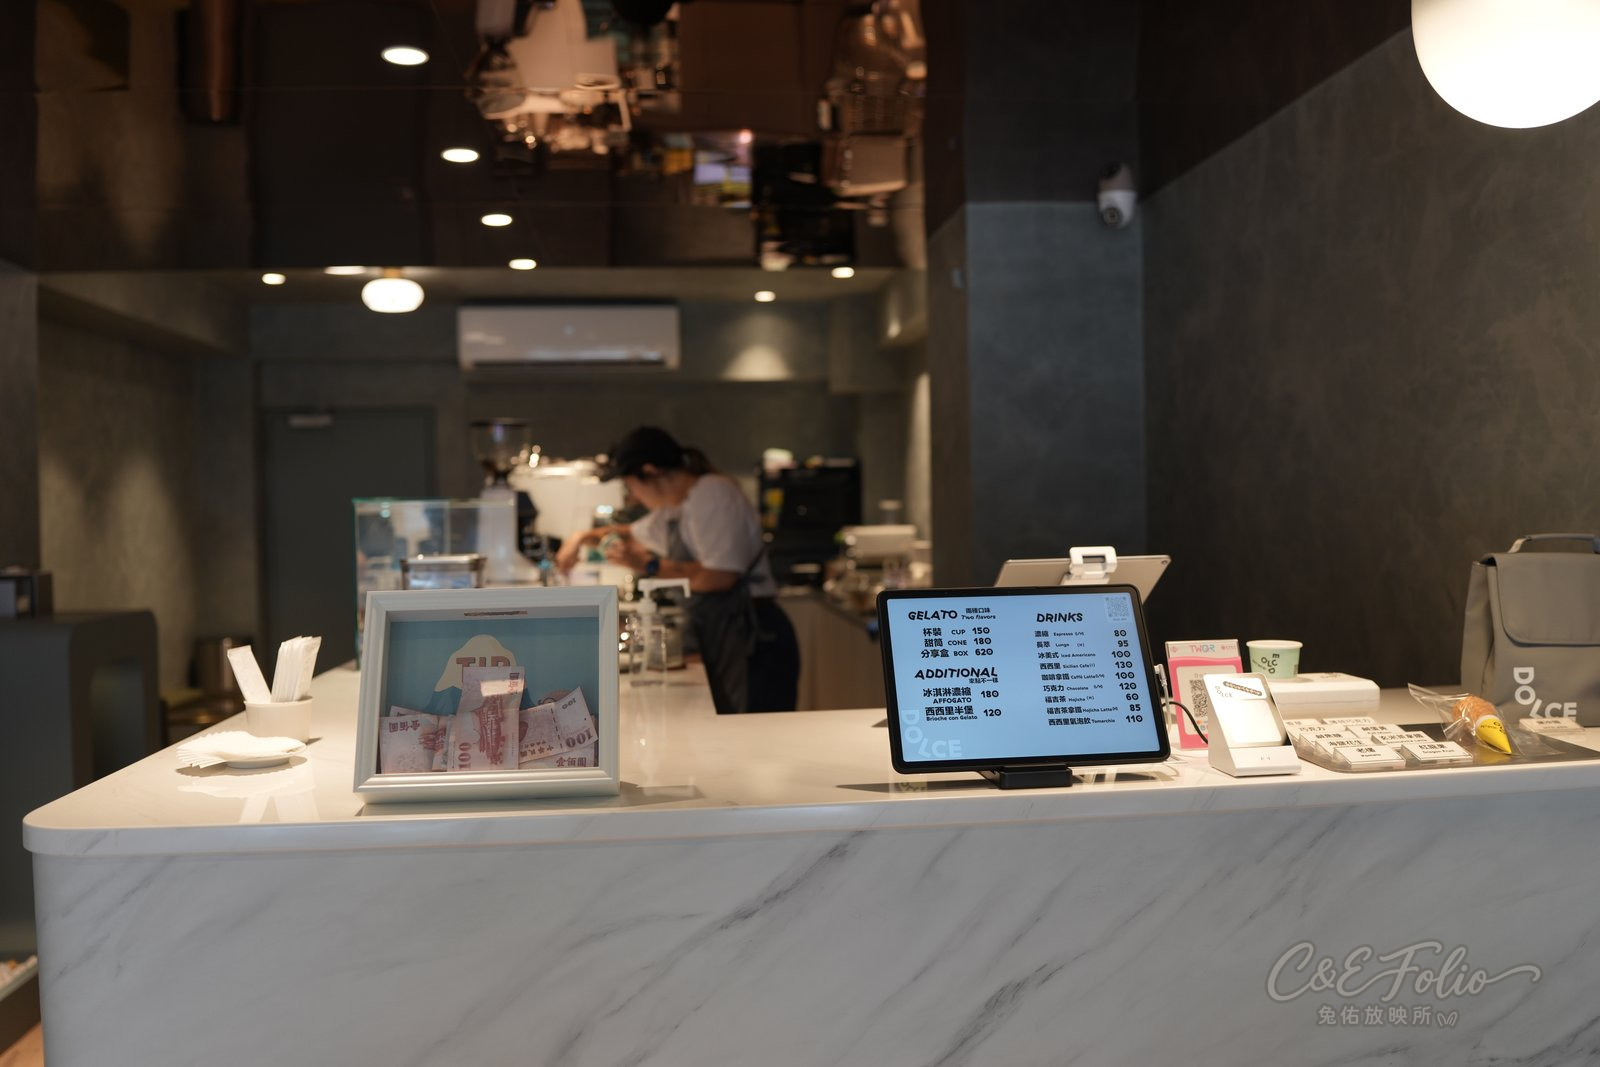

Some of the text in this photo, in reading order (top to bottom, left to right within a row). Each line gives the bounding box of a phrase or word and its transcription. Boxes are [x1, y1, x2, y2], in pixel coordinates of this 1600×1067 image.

[908, 610, 958, 620] GELATO
[1036, 612, 1083, 623] DRINKS
[923, 628, 942, 636] 杯裝
[924, 638, 943, 647] 甜筒
[921, 649, 949, 658] 分享盒
[914, 667, 998, 680] ADDITIONAL
[923, 687, 971, 697] 冰淇淋濃縮
[1513, 666, 1577, 721] DOLCE
[925, 706, 974, 716] 西西里半堡
[565, 728, 593, 748] 100
[902, 709, 962, 758] DOLCE
[458, 742, 472, 769] 100
